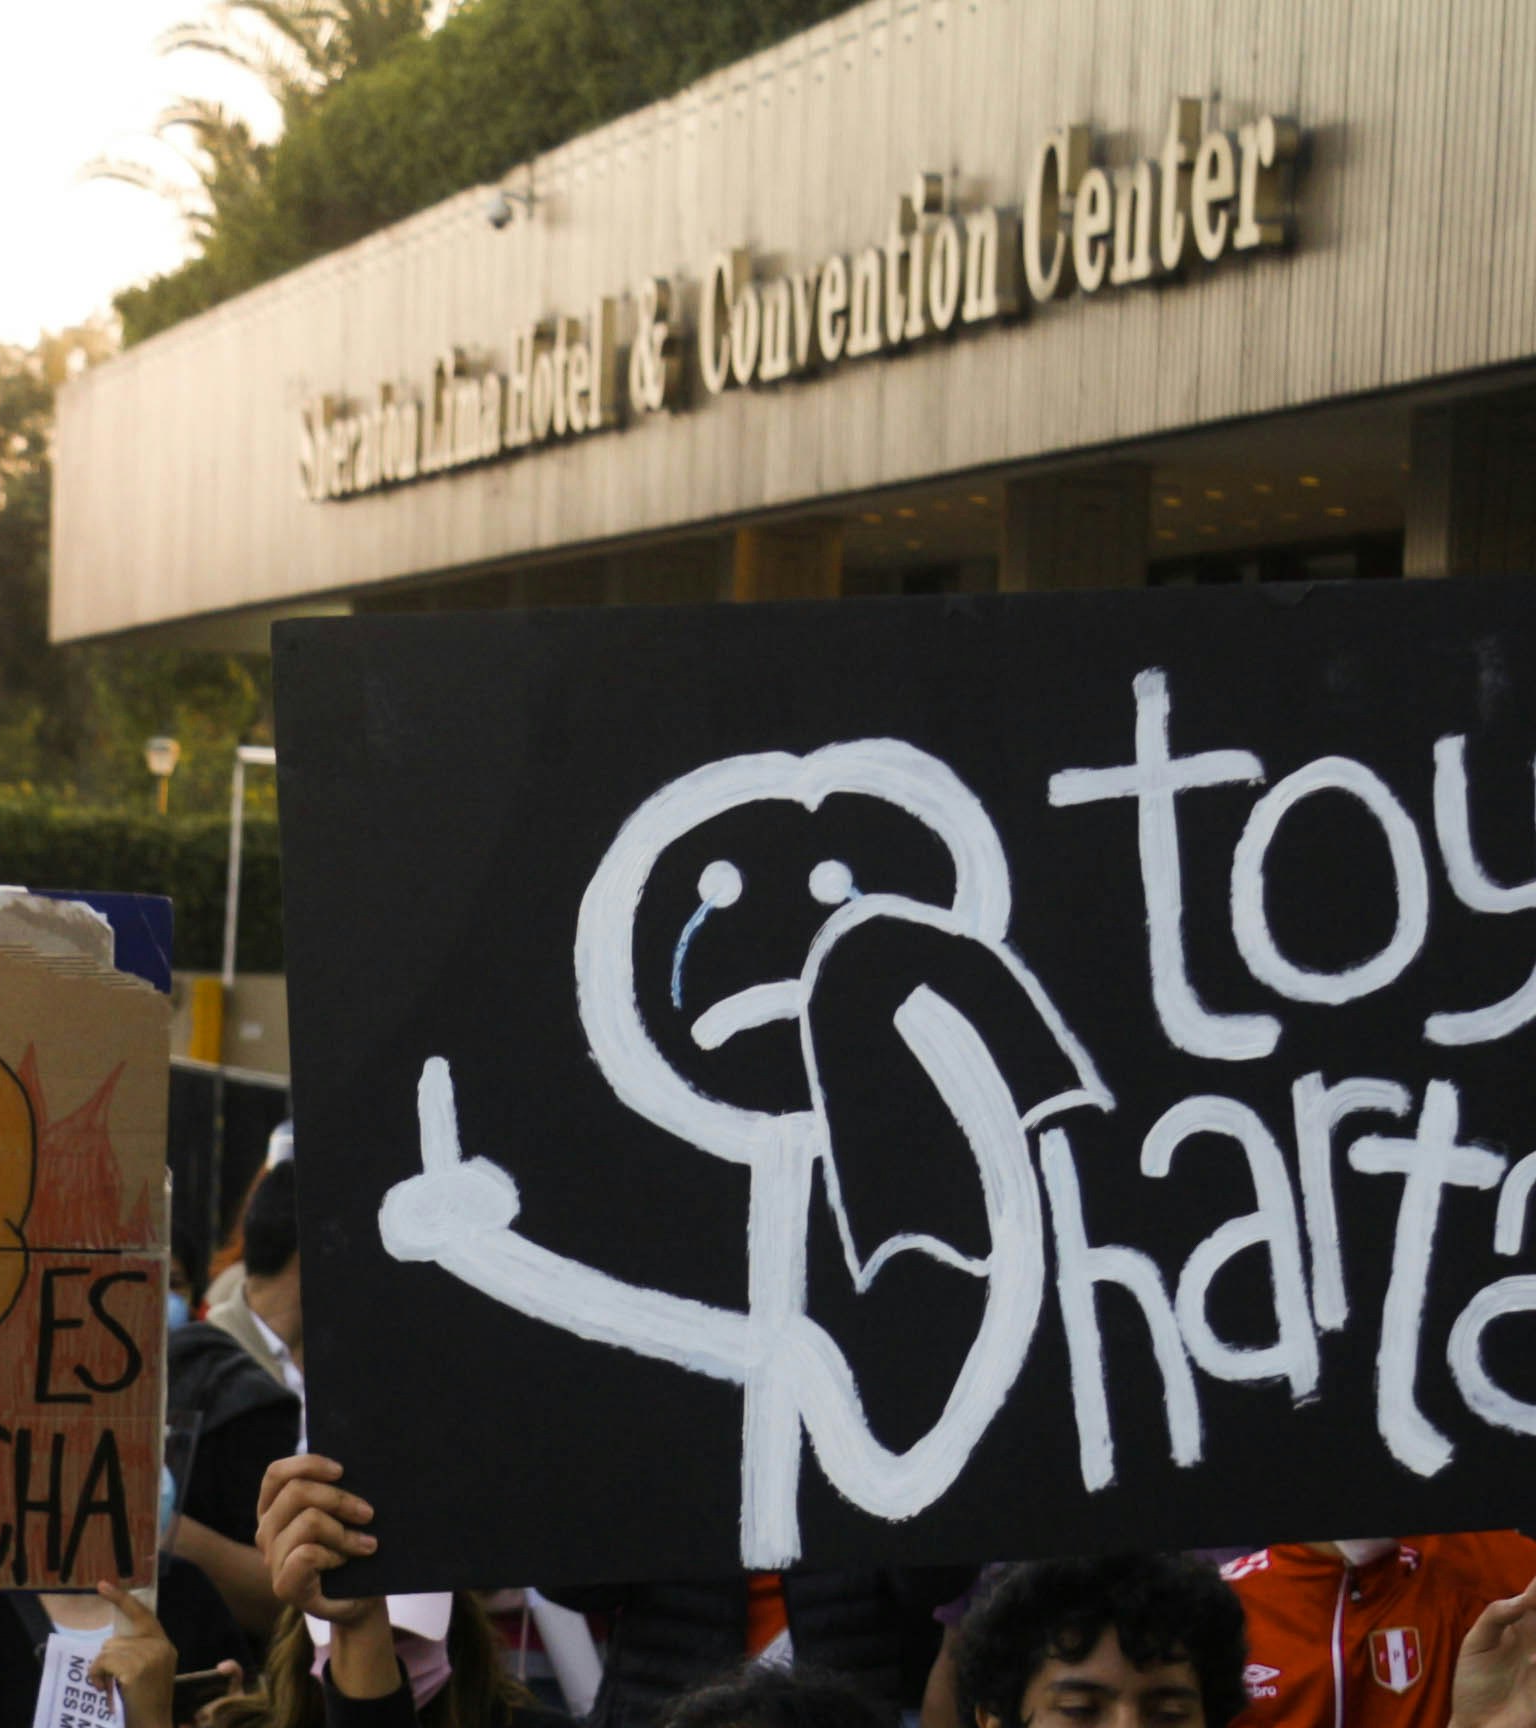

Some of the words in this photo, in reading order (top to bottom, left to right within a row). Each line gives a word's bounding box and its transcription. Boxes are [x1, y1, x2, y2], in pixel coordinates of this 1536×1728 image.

[300, 383, 417, 503] Sheraton
[418, 352, 501, 474] Lima
[507, 300, 606, 445] Hotel
[628, 277, 674, 414] &
[697, 176, 1001, 396] Convention
[1022, 104, 1278, 304] Center
[35, 1267, 148, 1406] ES
[67, 1655, 85, 1683] NO
[63, 1686, 80, 1710] ES
[80, 1691, 97, 1715] ES
